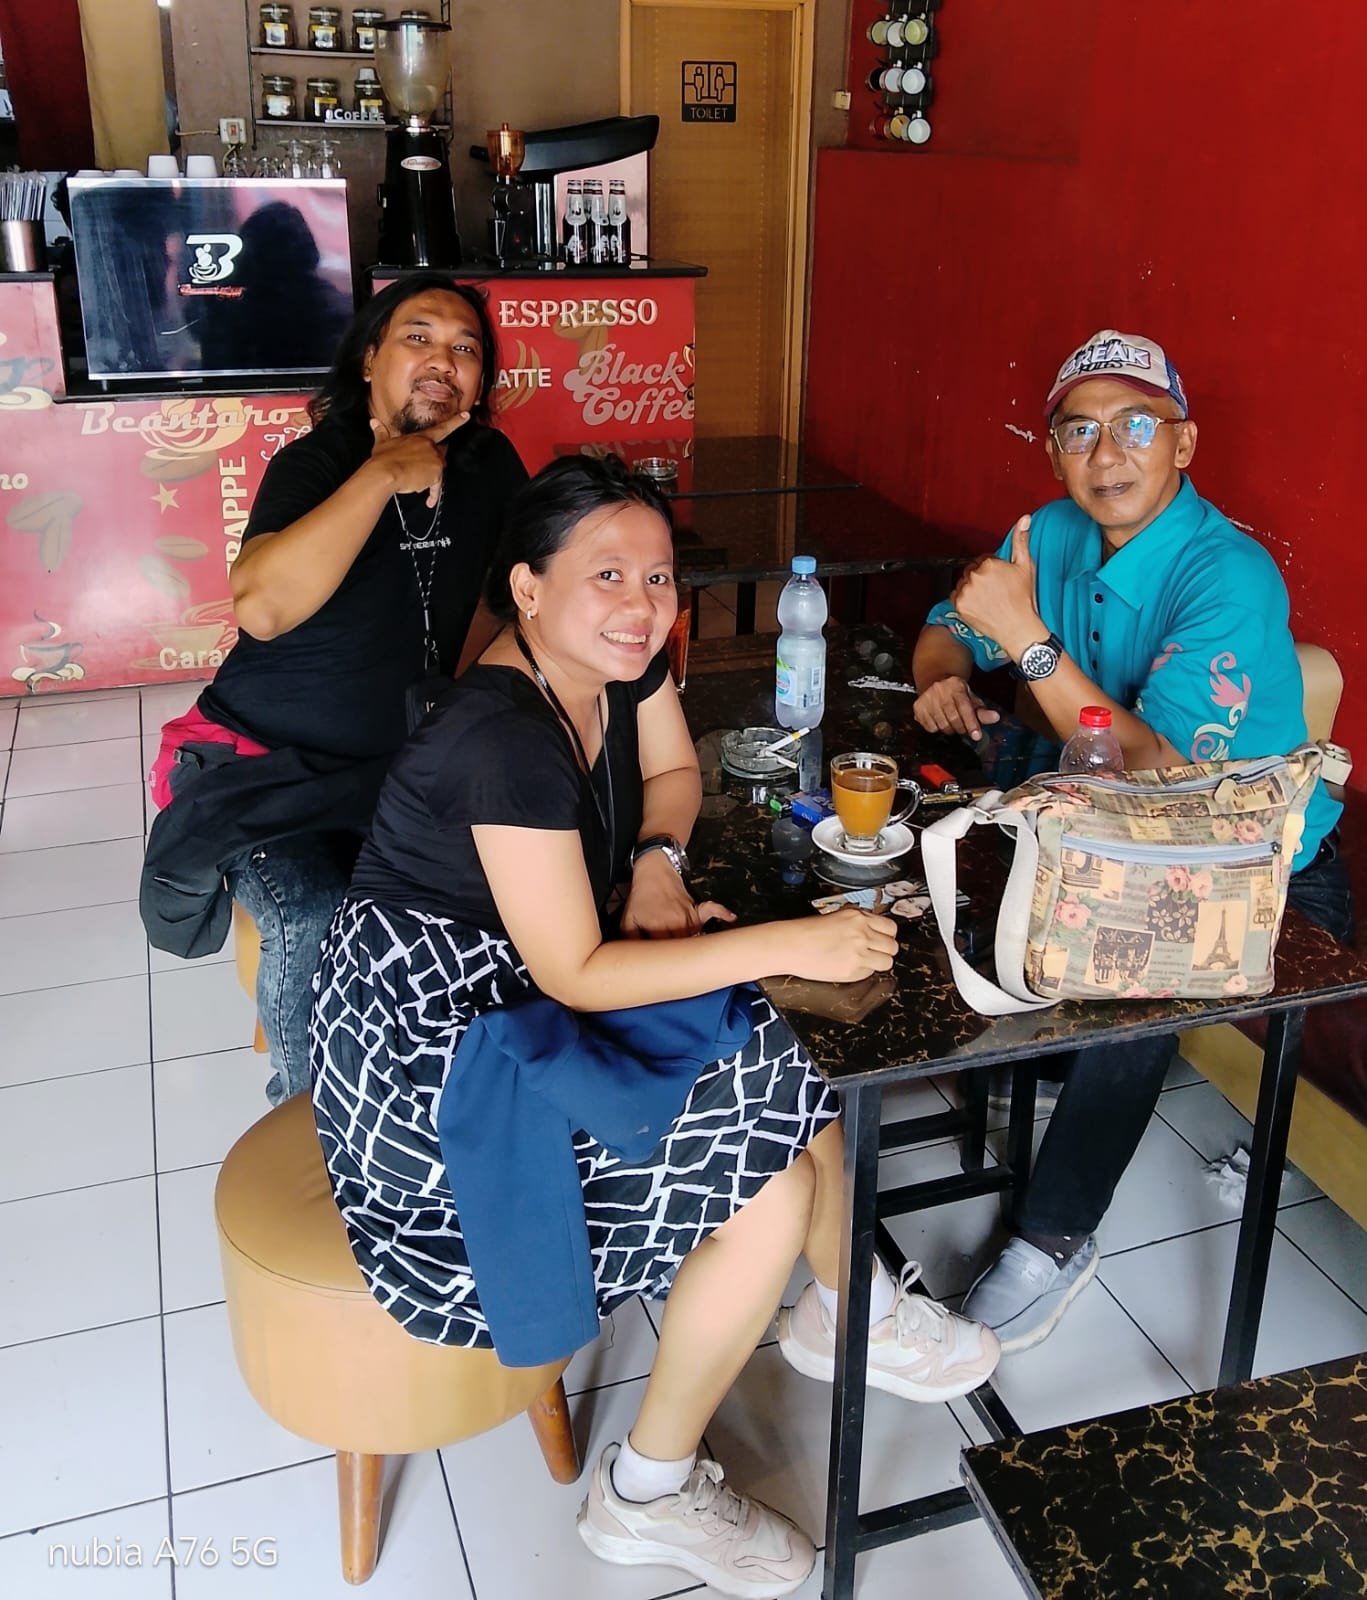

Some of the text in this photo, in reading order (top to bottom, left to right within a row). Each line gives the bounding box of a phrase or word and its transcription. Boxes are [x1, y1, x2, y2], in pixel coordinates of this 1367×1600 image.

[690, 107, 728, 120] TOILET
[499, 298, 658, 328] ESPRESSO
[492, 367, 552, 389] ATTE
[563, 343, 687, 394] Black
[75, 402, 304, 435] Beantaro
[573, 387, 695, 426] Coffee
[218, 456, 249, 583] RAPPE
[159, 647, 231, 671] Cara
